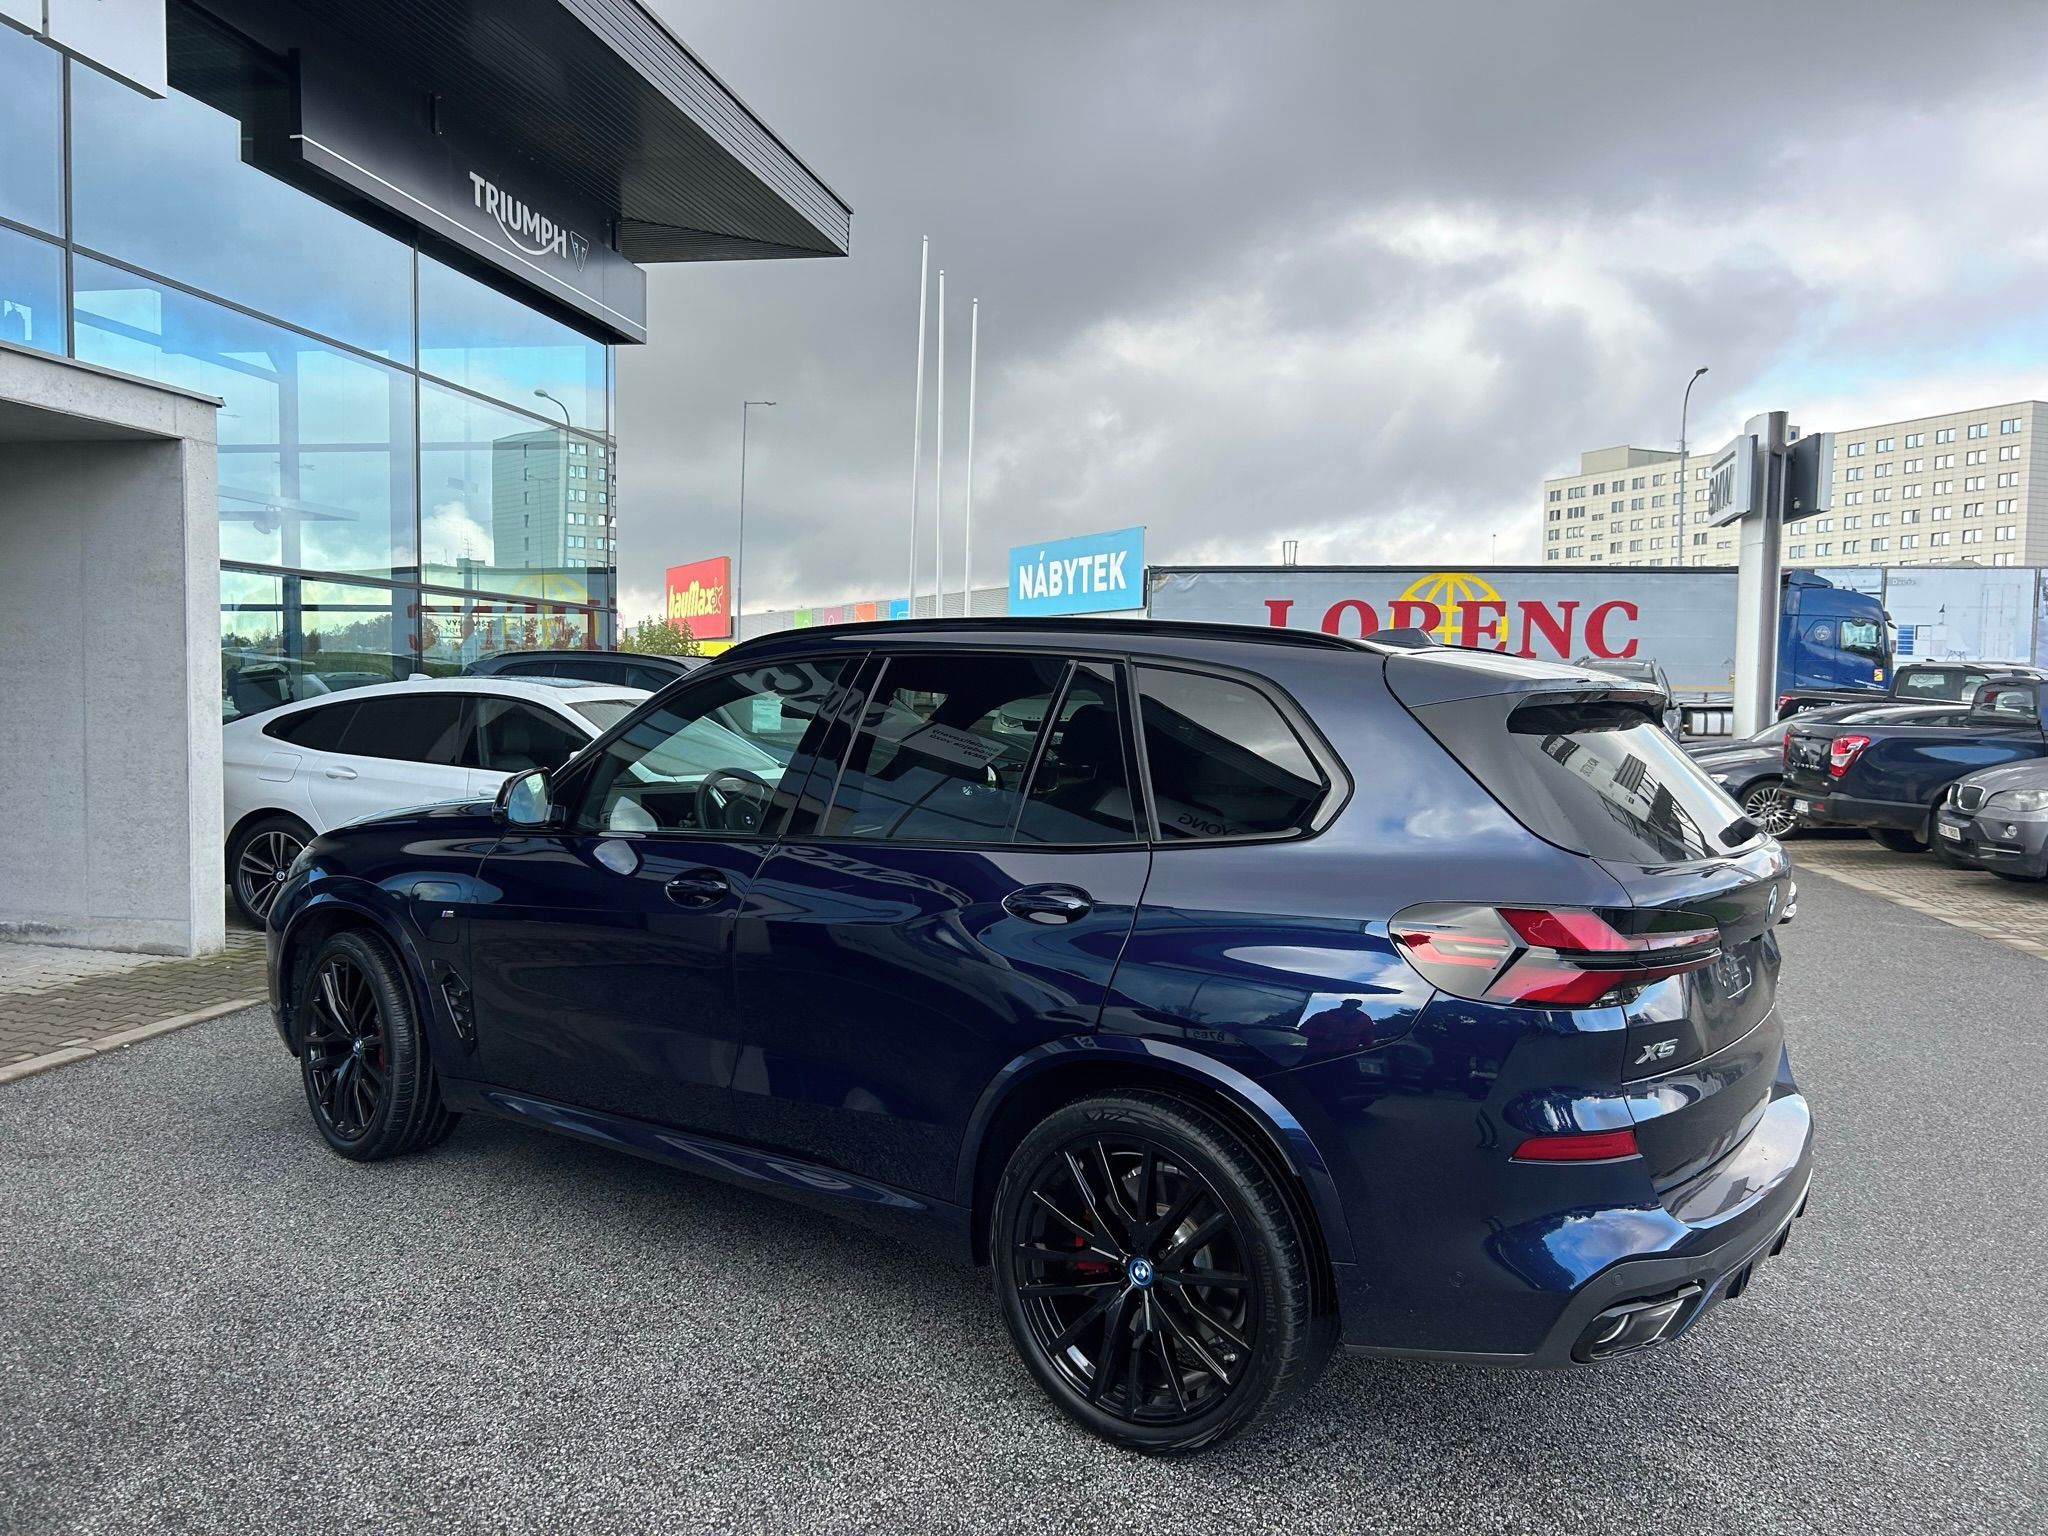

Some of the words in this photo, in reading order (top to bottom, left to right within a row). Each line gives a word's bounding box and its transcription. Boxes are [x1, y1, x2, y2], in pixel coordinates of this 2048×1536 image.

[469, 170, 567, 259] TRIUMPH
[1019, 550, 1128, 600] NÁBYTEK
[1634, 1038, 1680, 1066] X5
